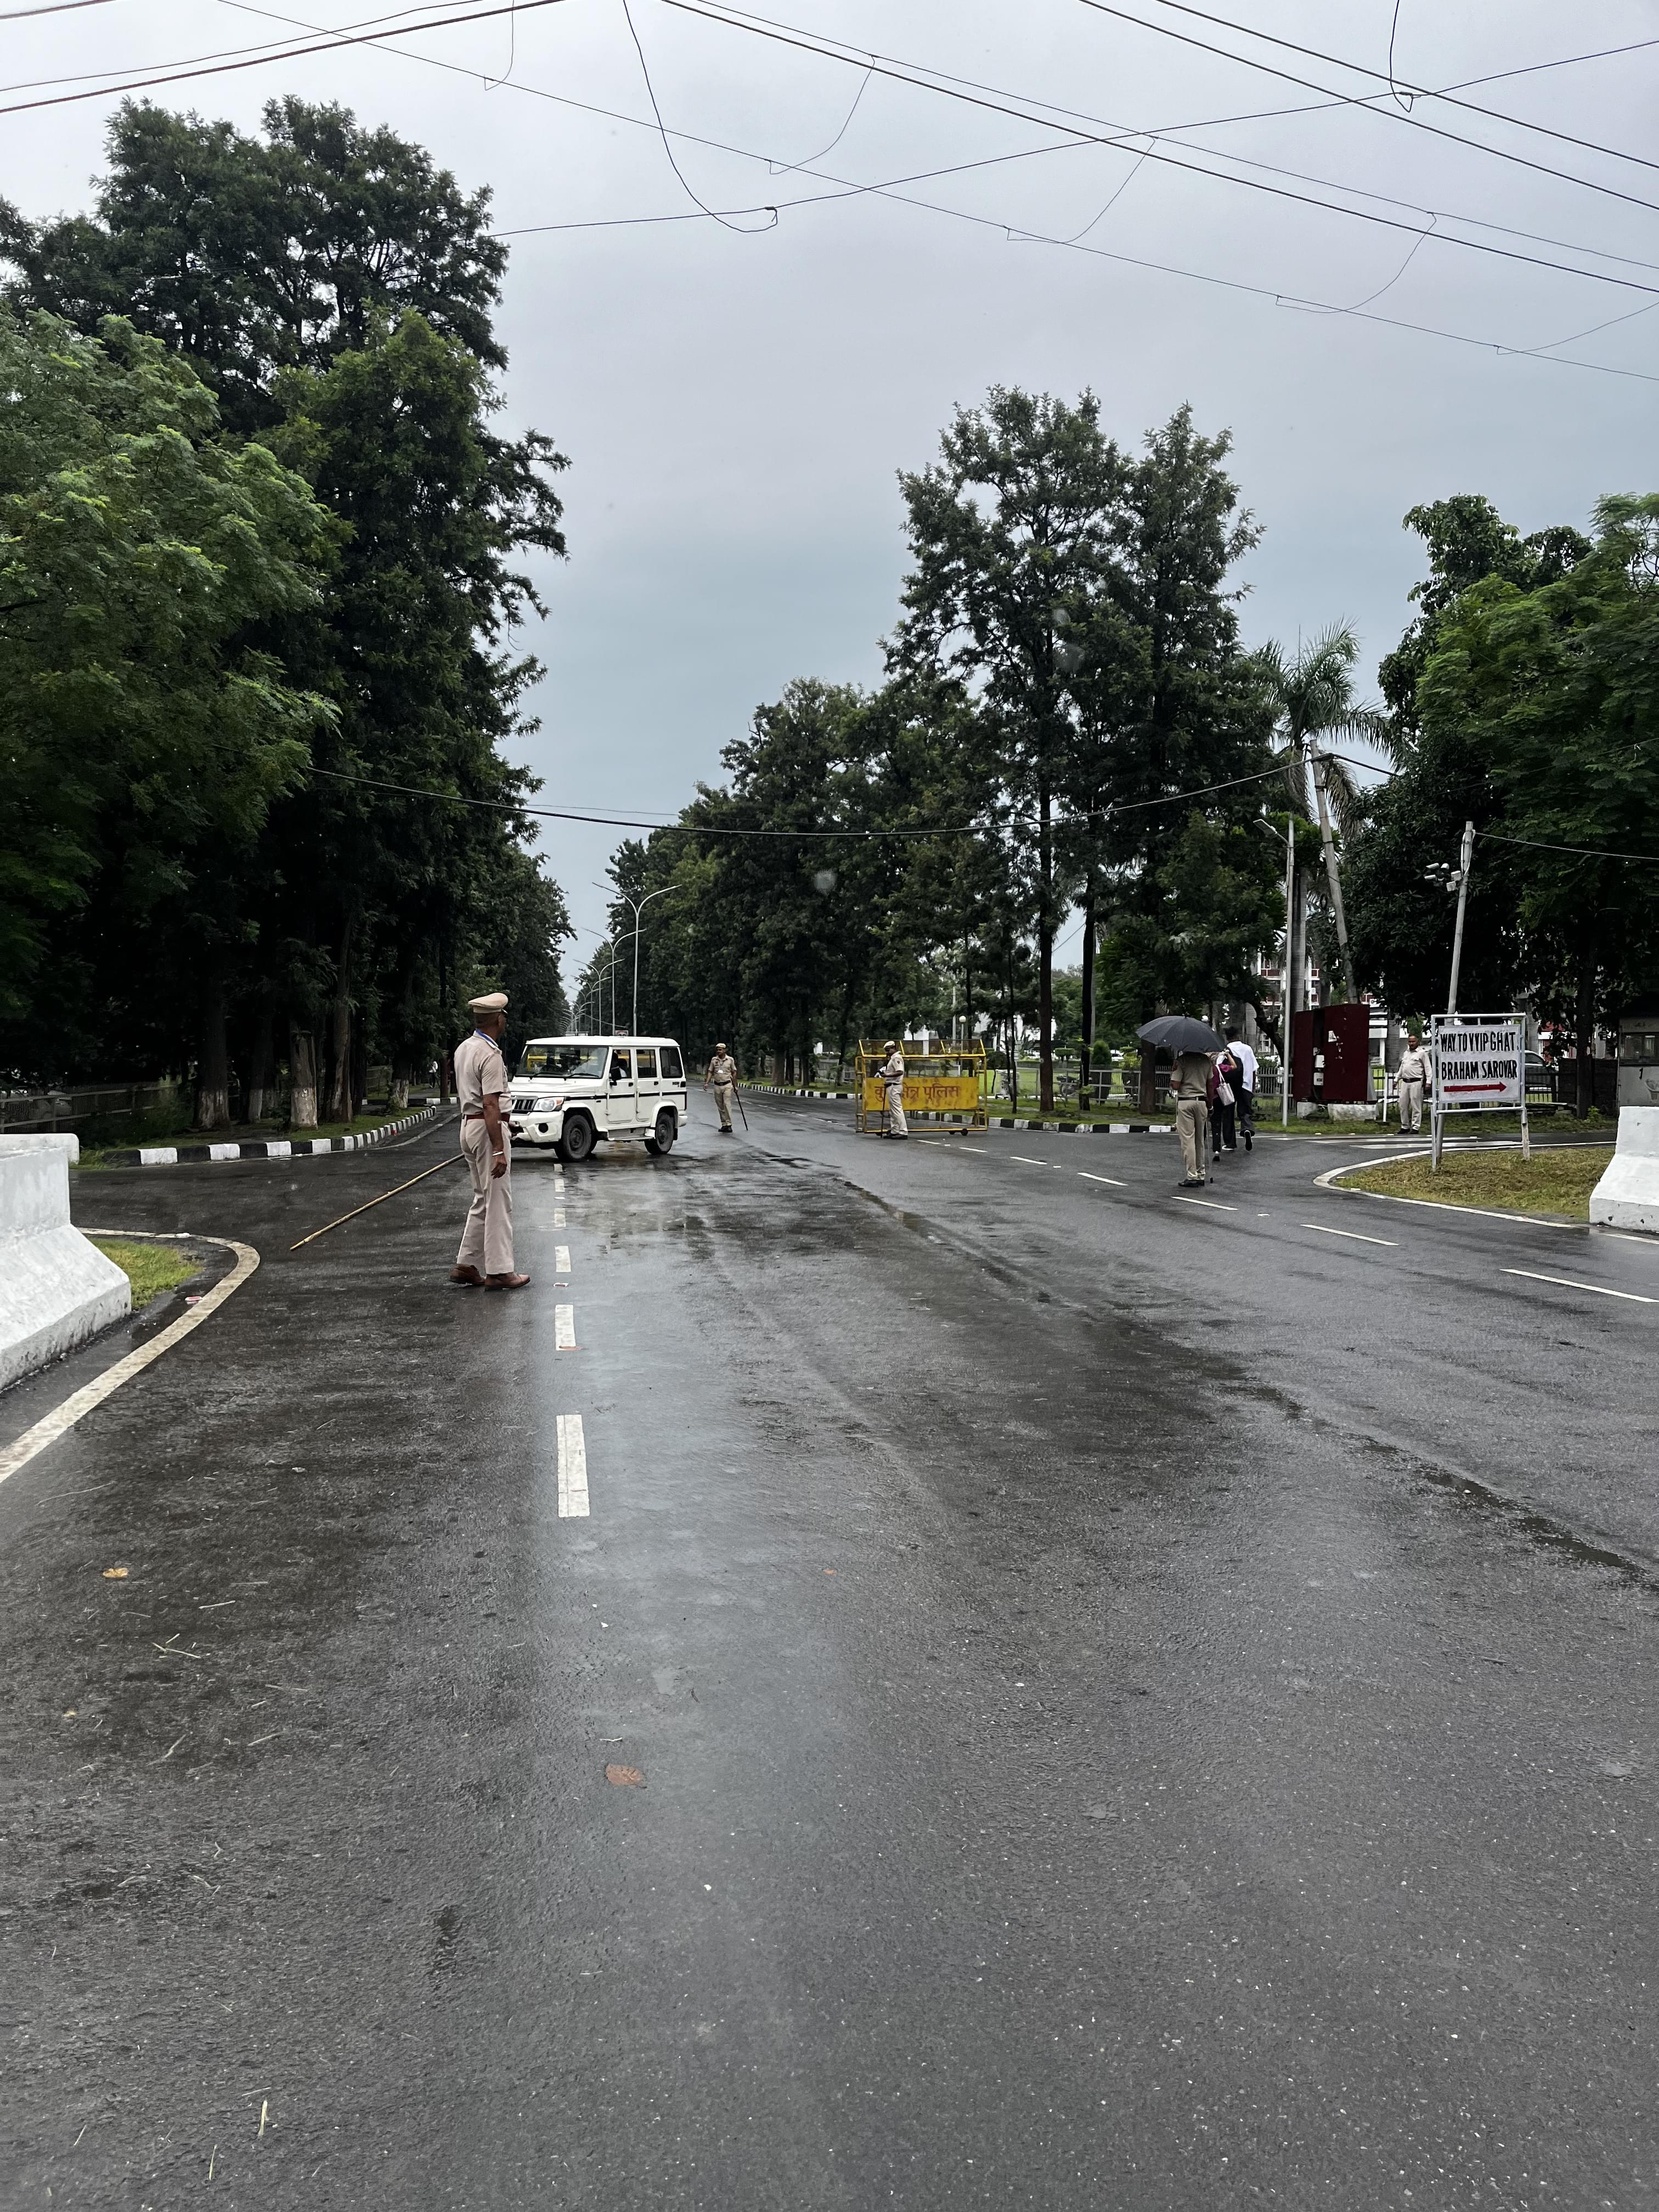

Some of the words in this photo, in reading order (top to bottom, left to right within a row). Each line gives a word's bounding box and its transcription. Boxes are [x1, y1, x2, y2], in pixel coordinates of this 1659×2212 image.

[1440, 1034, 1456, 1052] WAY
[1457, 1032, 1467, 1052] TO
[1469, 1032, 1488, 1051] VVIP
[1490, 1031, 1516, 1051] GHAT
[1441, 1062, 1479, 1080] BRAHAM
[1481, 1060, 1517, 1079] SAROVAR
